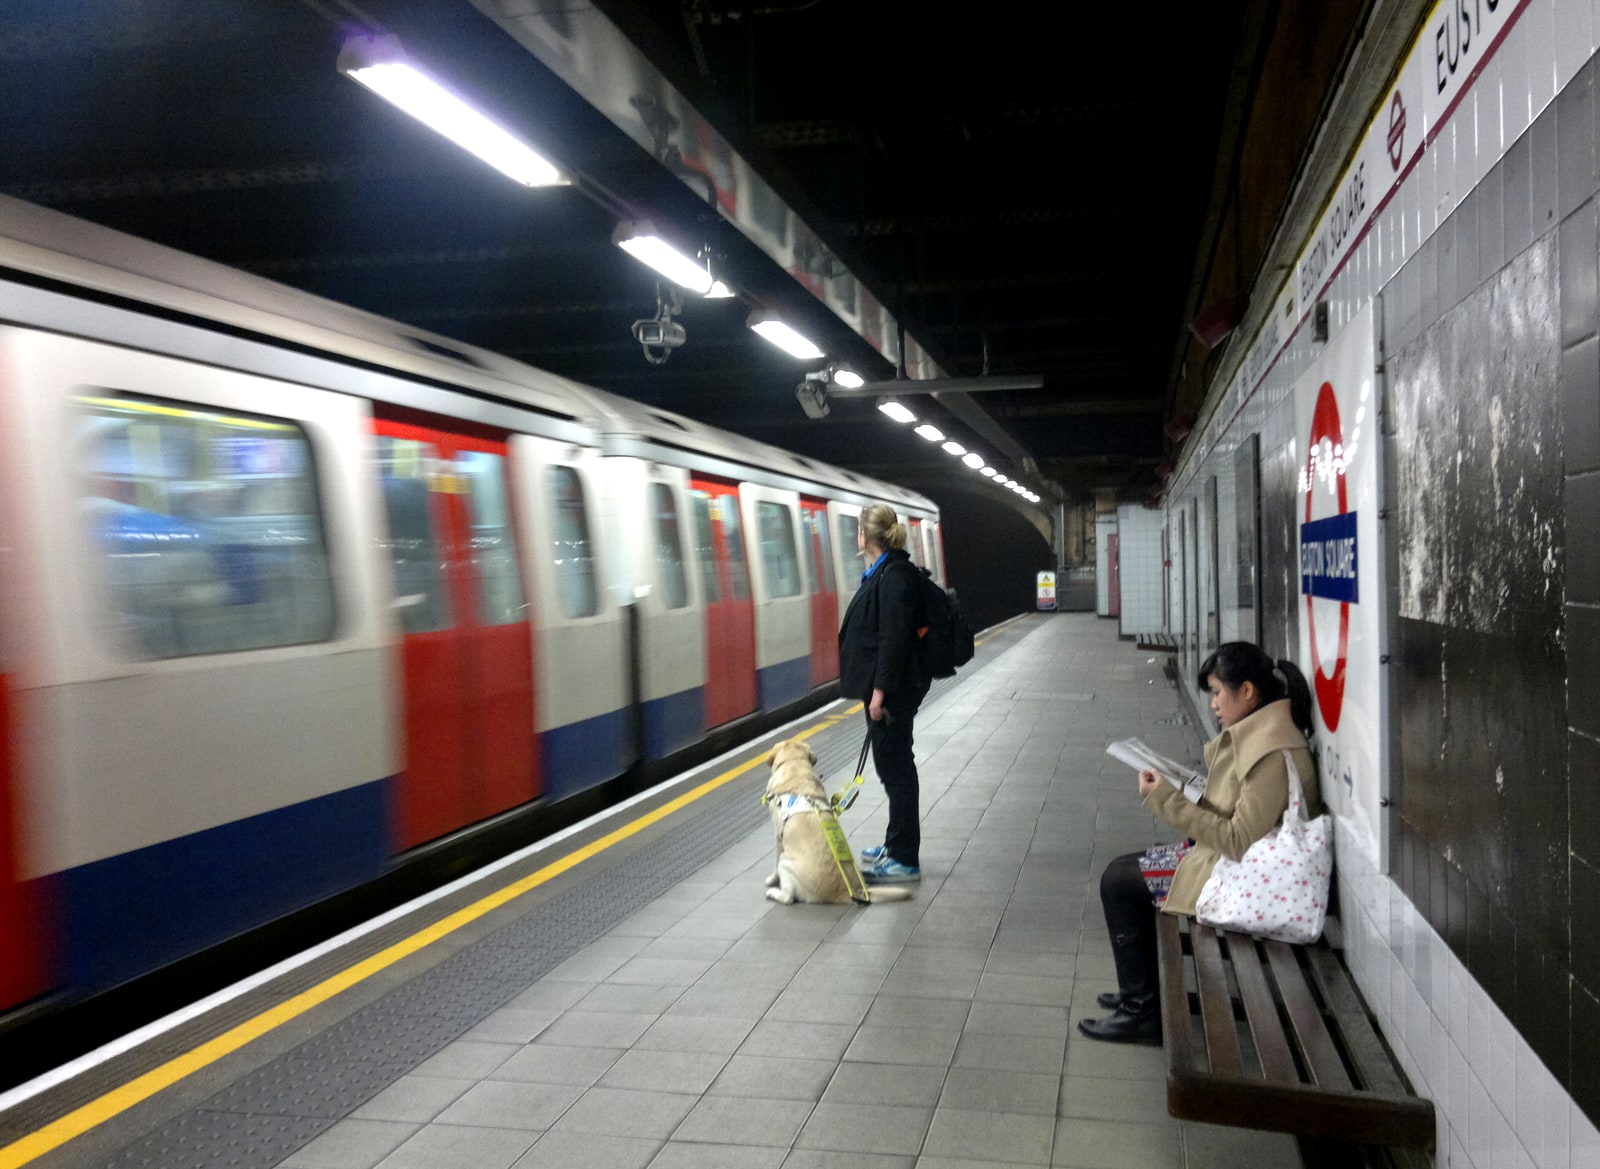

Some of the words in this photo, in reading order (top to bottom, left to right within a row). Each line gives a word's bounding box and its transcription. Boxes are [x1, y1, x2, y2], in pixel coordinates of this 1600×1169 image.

[1436, 0, 1500, 96] EUS
[1330, 160, 1366, 257] SQUARE
[1325, 537, 1355, 579] SQUARE
